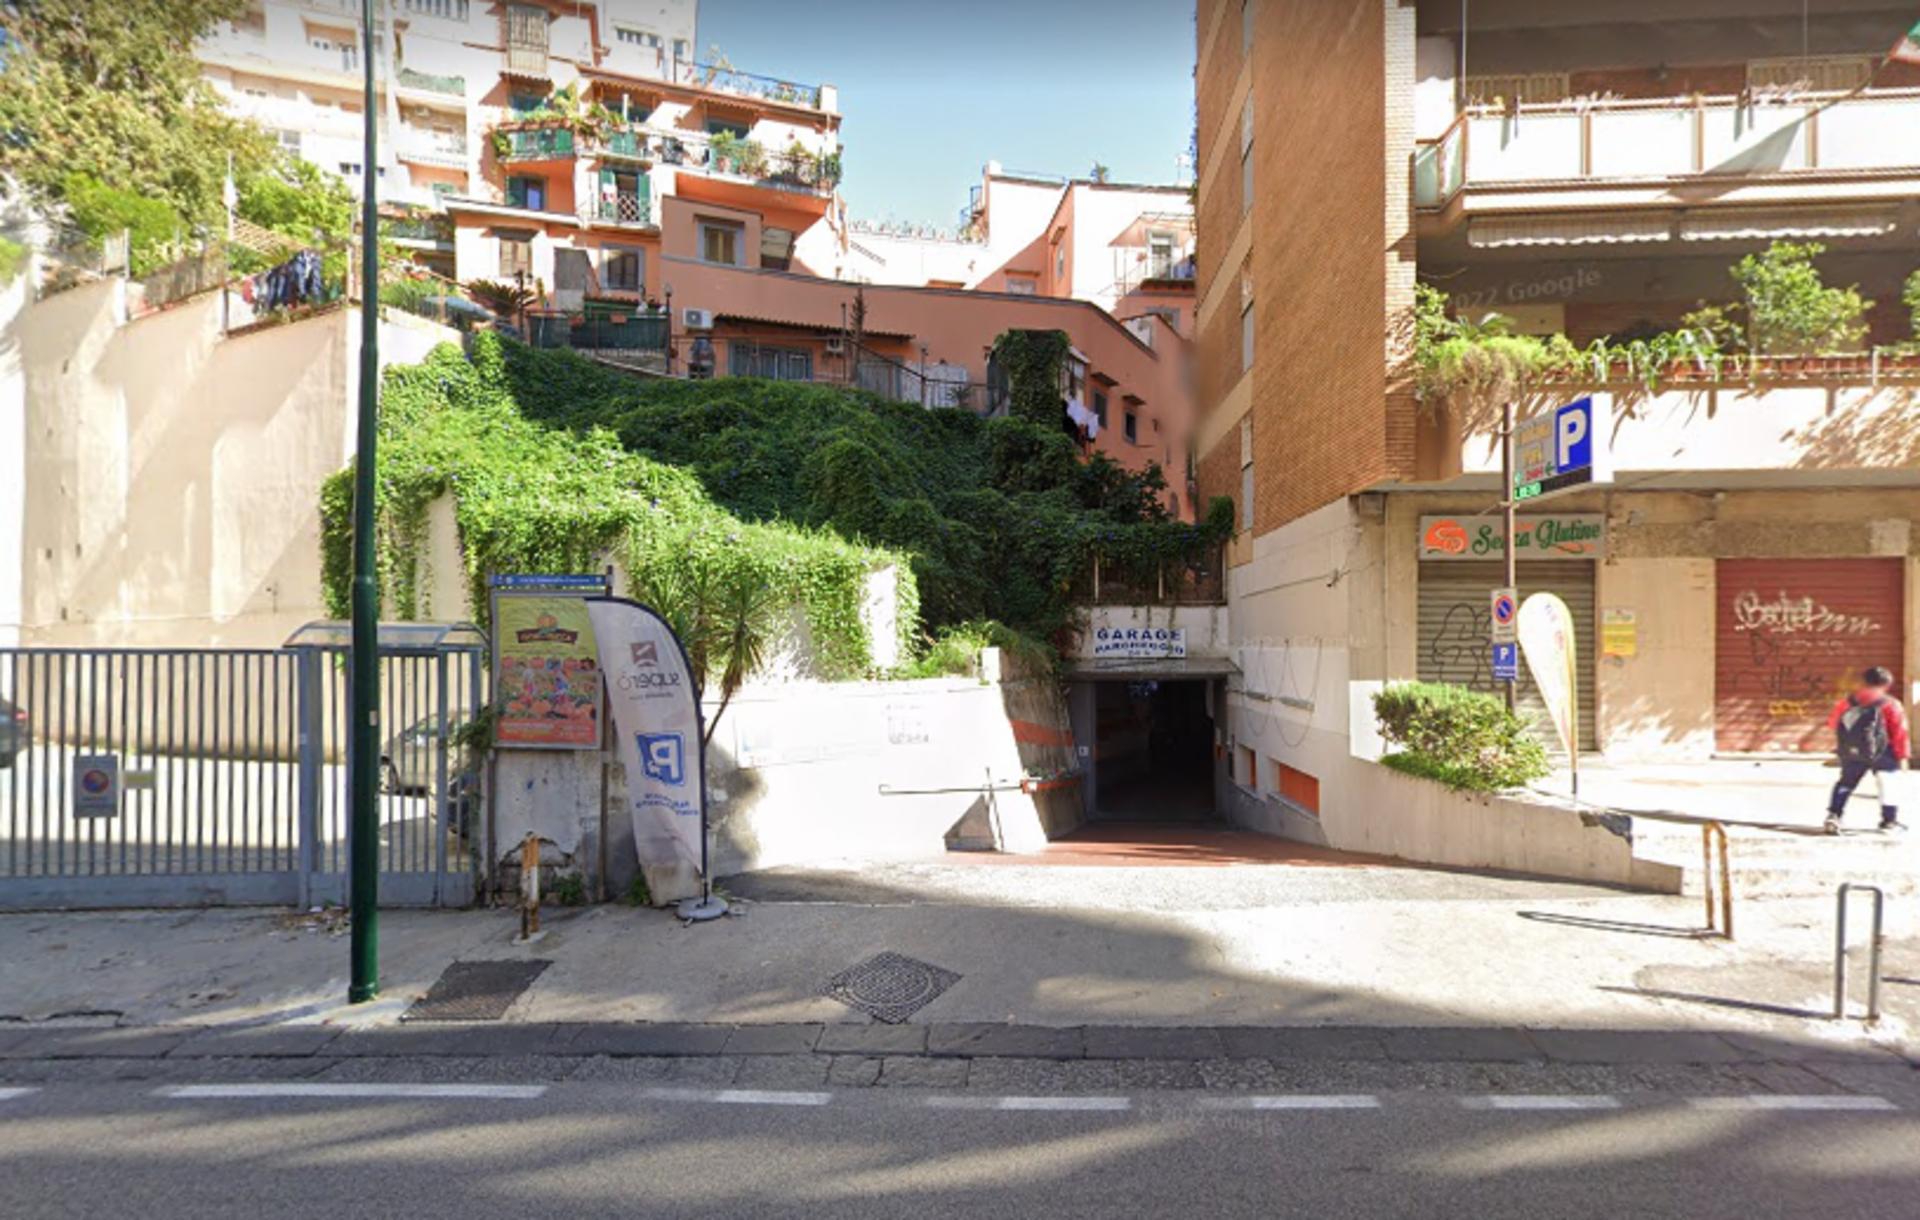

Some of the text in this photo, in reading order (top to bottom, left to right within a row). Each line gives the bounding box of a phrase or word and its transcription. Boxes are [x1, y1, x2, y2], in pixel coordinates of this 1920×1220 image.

[1559, 408, 1587, 467] P
[1535, 519, 1601, 551] Glutine
[1097, 627, 1181, 641] GARAGE
[1500, 646, 1509, 661] P
